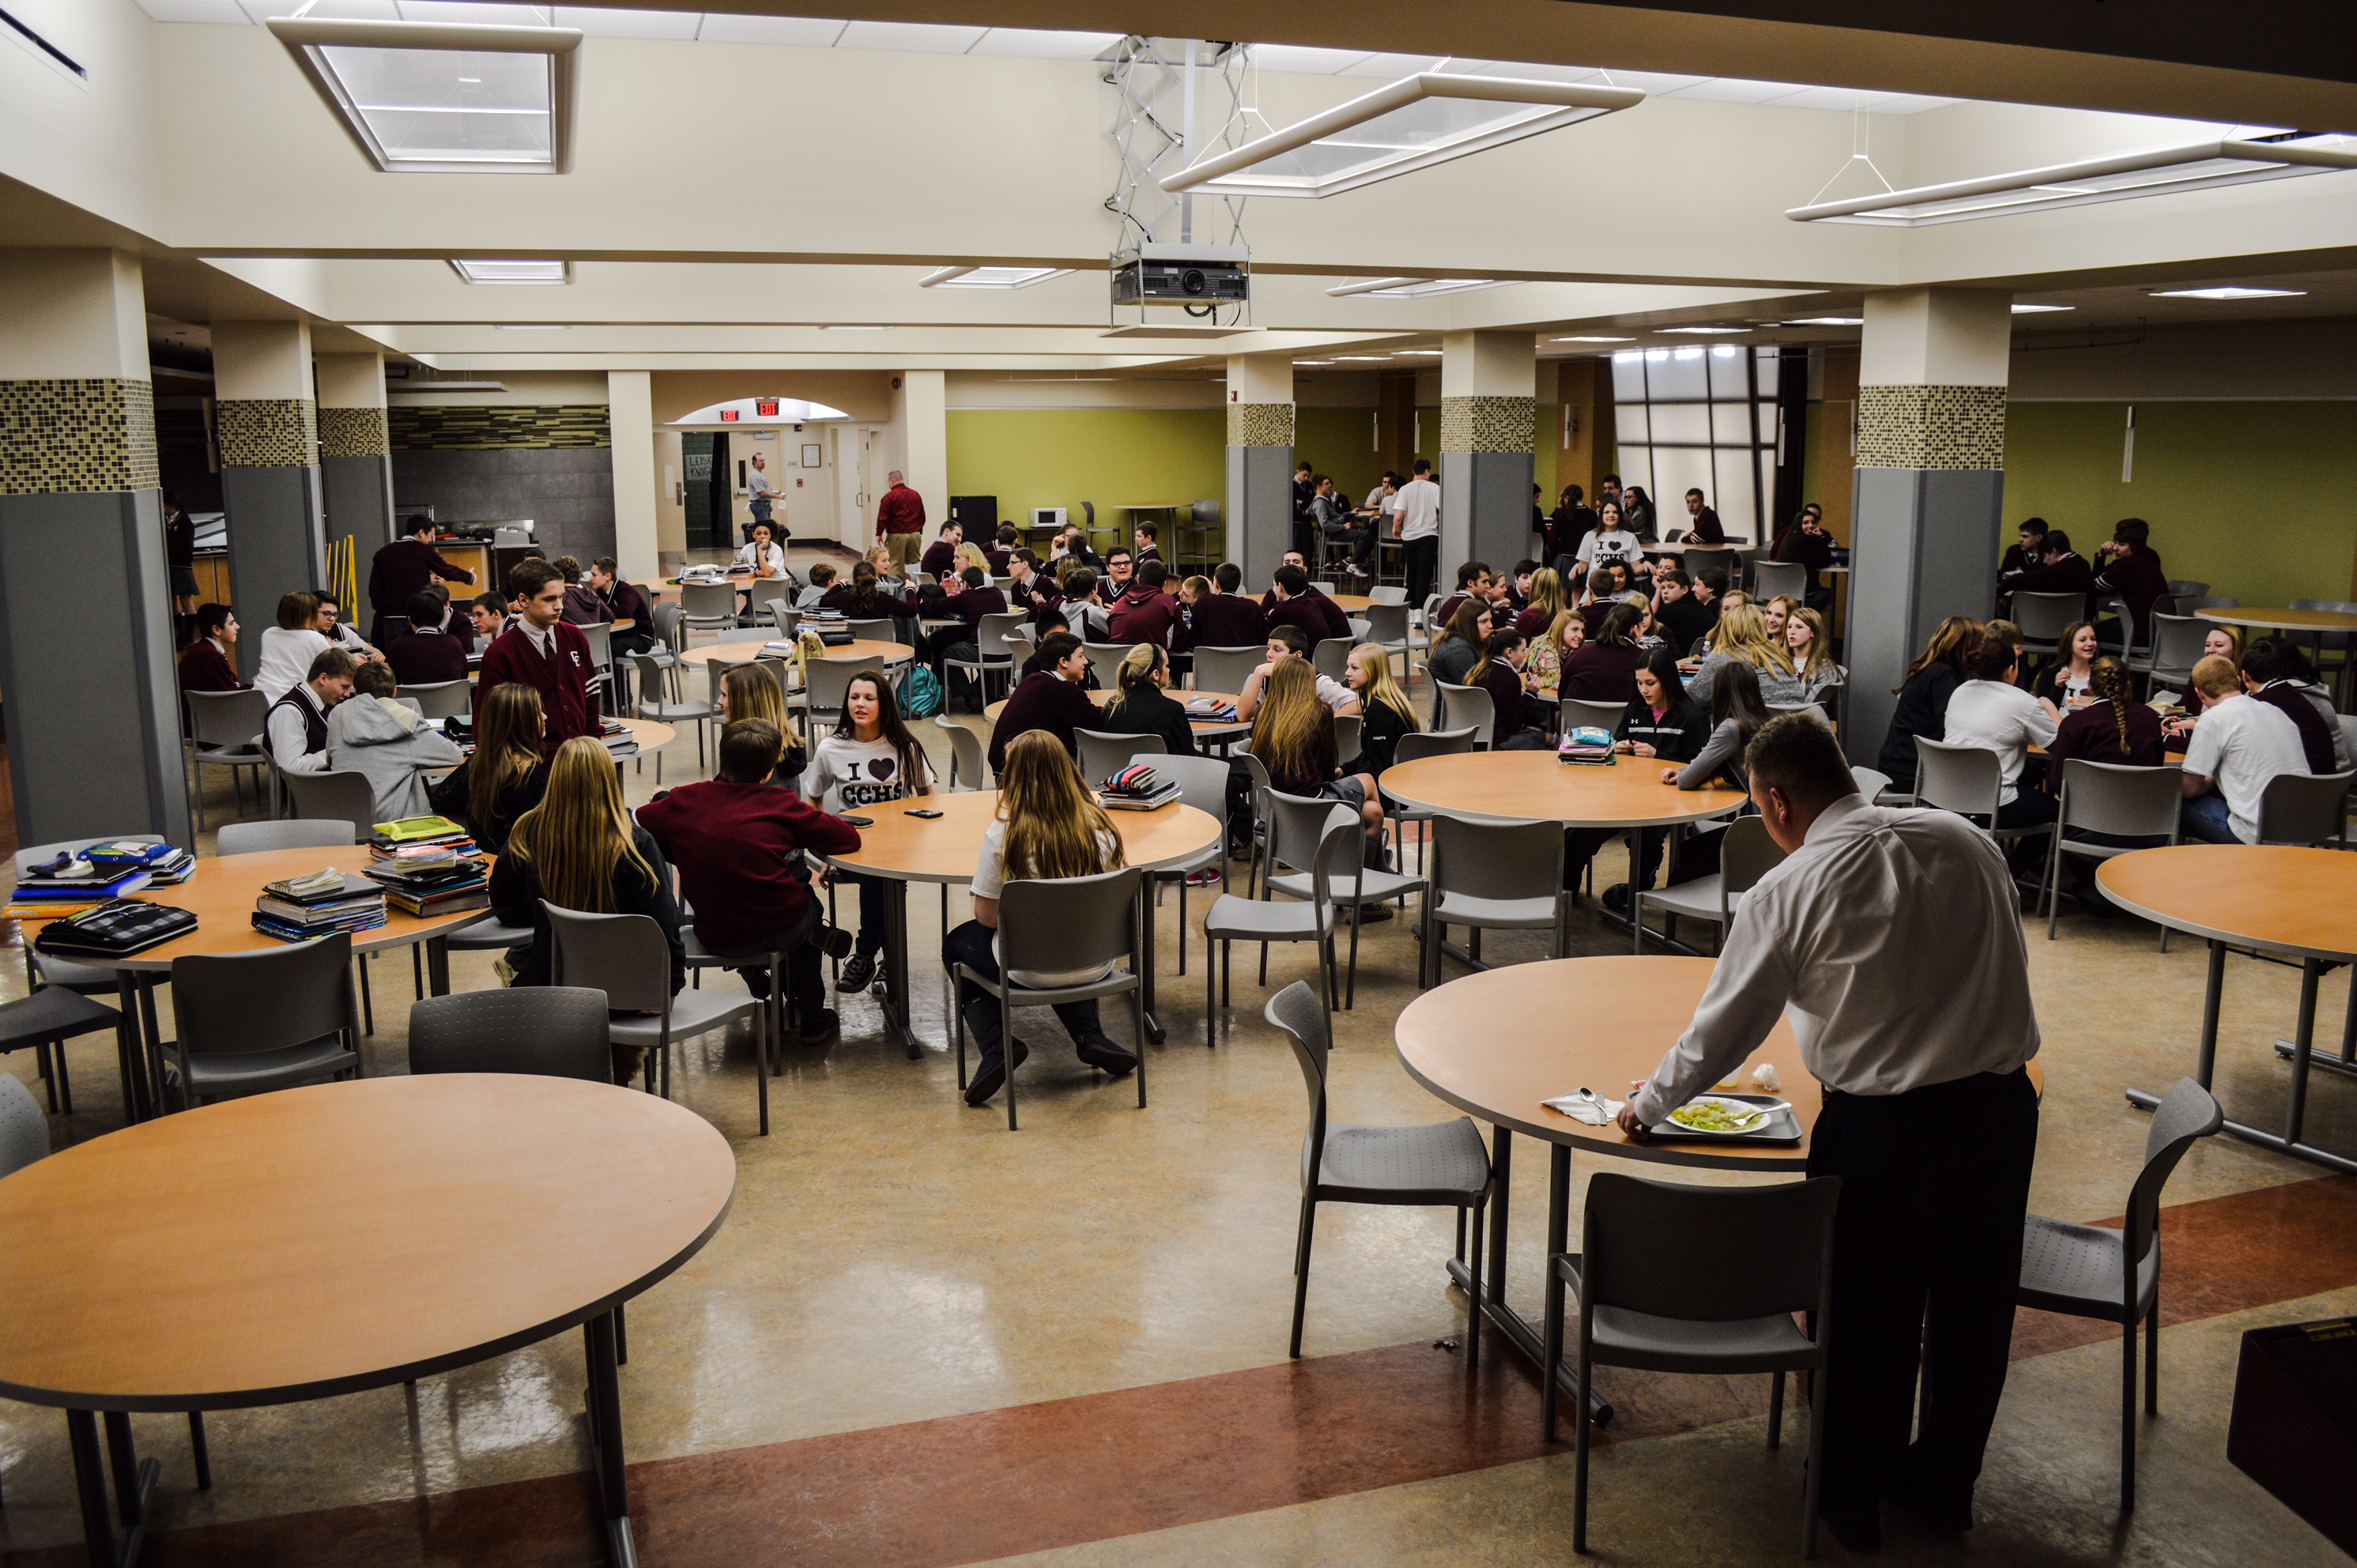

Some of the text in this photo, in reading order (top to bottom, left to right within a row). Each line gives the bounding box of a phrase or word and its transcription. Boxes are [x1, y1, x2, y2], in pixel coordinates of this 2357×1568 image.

[723, 410, 737, 421] EXIT
[760, 402, 776, 416] EXIT
[1597, 541, 1605, 550] I
[847, 762, 862, 782] I
[842, 781, 903, 805] CCHS
